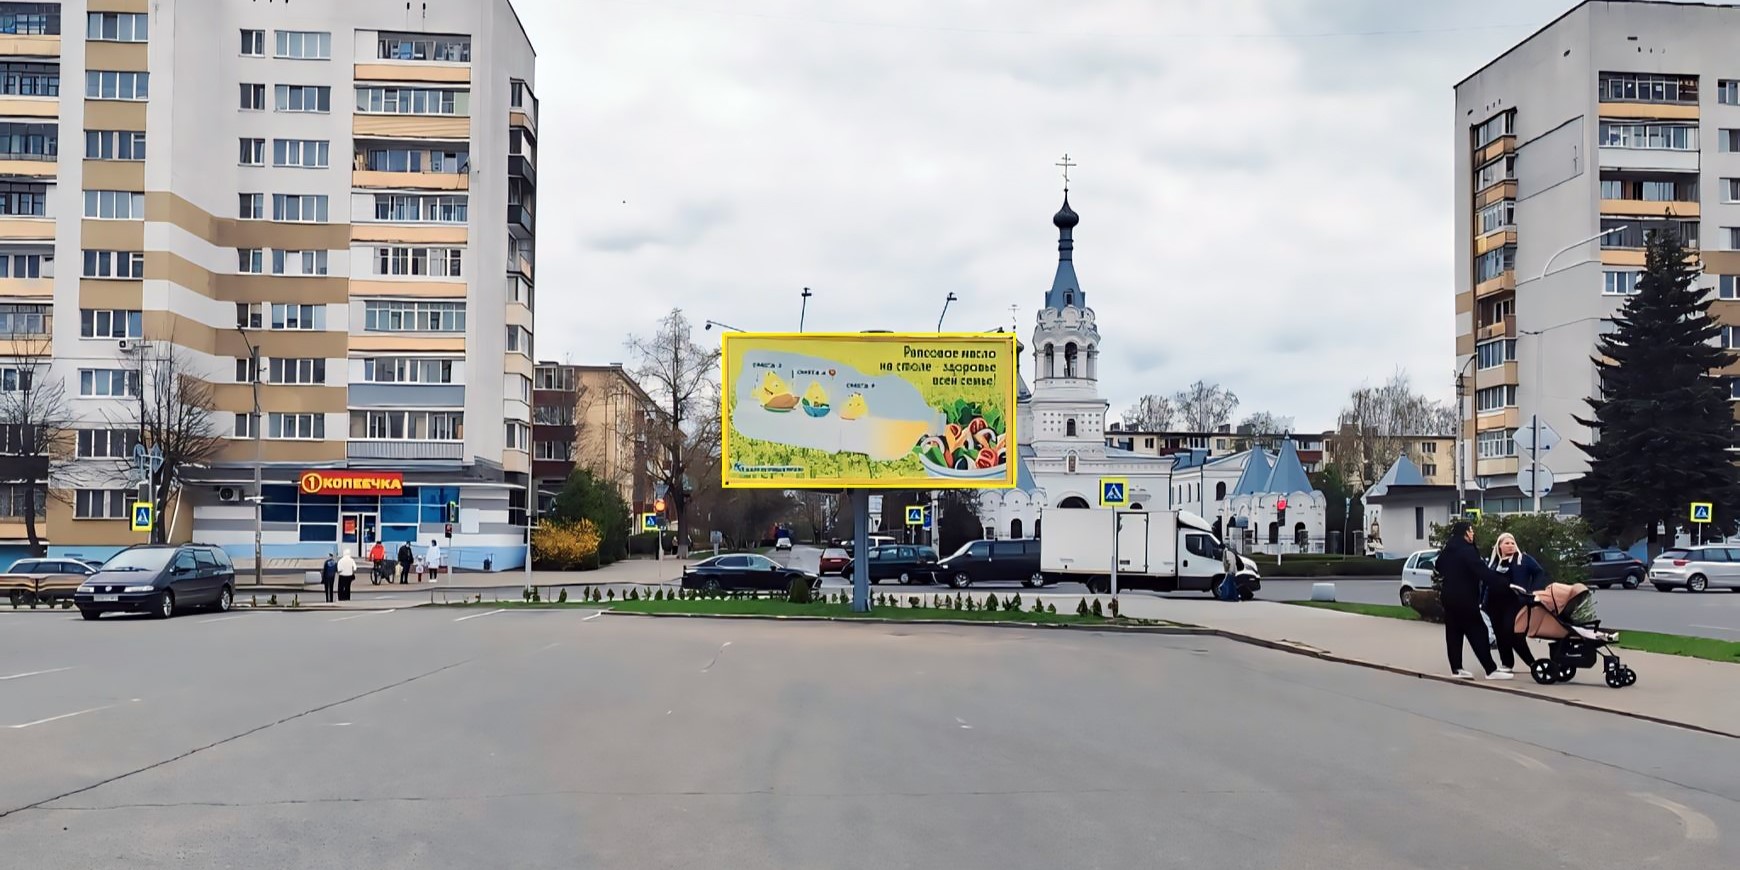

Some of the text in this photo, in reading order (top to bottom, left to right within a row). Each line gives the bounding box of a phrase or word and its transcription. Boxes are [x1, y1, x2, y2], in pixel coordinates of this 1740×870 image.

[904, 345, 996, 359] Рапсовое масло
[879, 362, 893, 371] на
[896, 362, 932, 372] столе
[942, 363, 996, 377] здоровье
